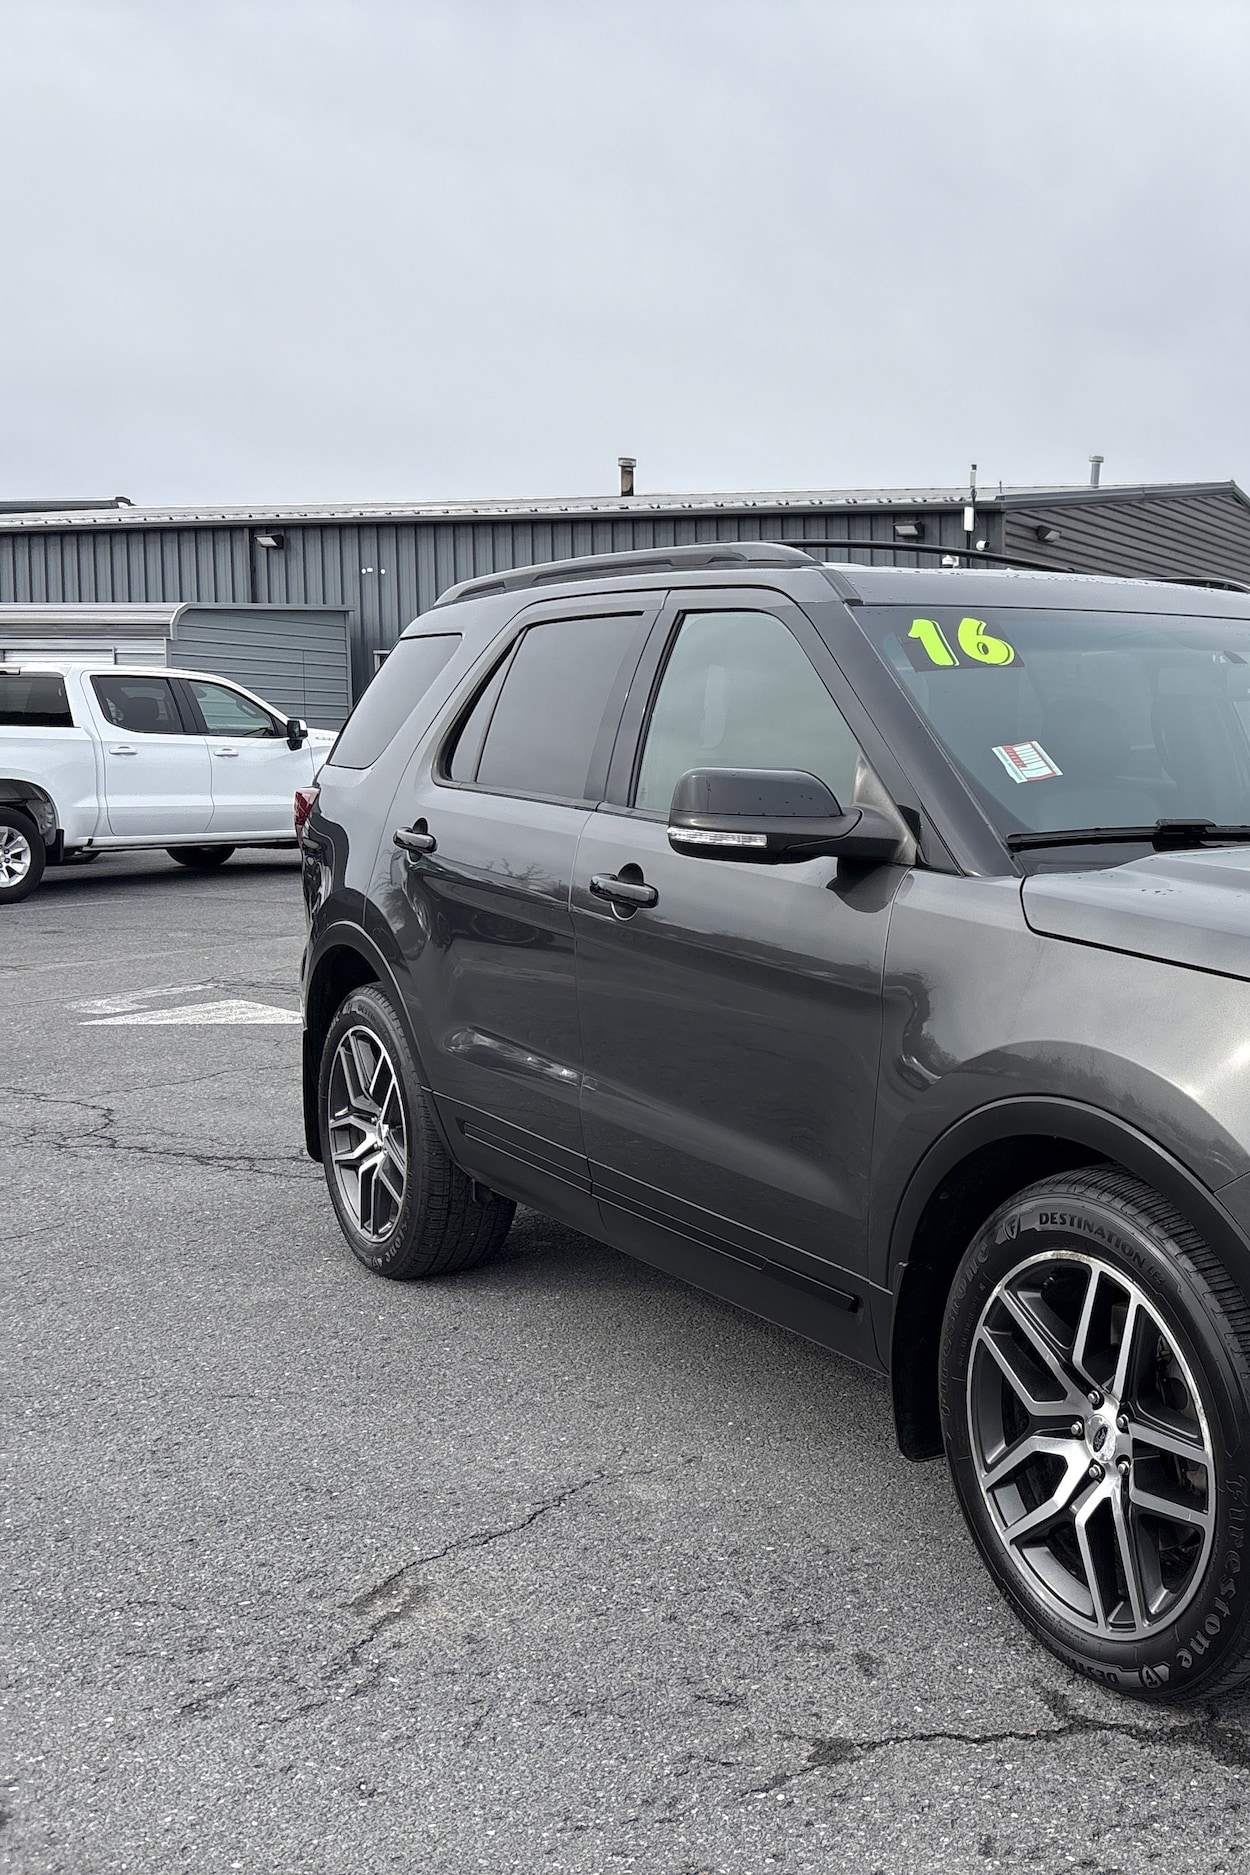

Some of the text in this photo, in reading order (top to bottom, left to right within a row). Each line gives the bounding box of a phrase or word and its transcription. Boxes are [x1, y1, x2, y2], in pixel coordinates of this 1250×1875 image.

[907, 617, 1015, 666] 16
[1039, 1202, 1146, 1269] DESTINATION
[1176, 1475, 1249, 1670] Firestone
